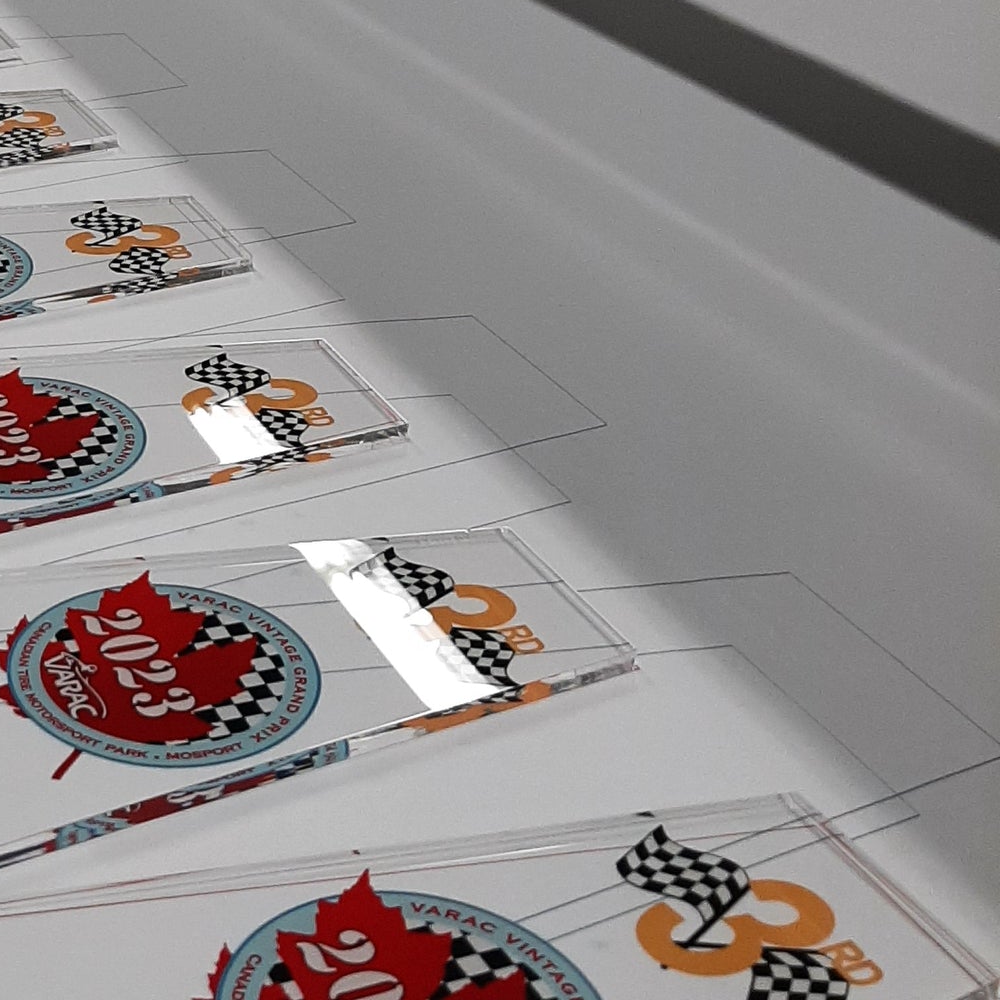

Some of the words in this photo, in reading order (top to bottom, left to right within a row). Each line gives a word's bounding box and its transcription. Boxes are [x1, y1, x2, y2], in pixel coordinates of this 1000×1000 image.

[40, 382, 92, 398] VARAC
[95, 397, 134, 431] VINTAGE
[114, 433, 135, 465] GRAND
[176, 590, 243, 614] VARAC
[248, 611, 304, 662] VINTAGE
[43, 651, 99, 719] VARAC
[81, 608, 196, 718] 2023
[287, 667, 308, 714] GRAND
[25, 692, 103, 747] MOTORSPORT
[105, 743, 148, 759] PARK
[165, 741, 243, 760] MOSPORT
[250, 715, 291, 743] PRIX
[296, 929, 405, 1000] 20
[410, 902, 498, 934] VARAC
[504, 932, 585, 1000] VINTAG
